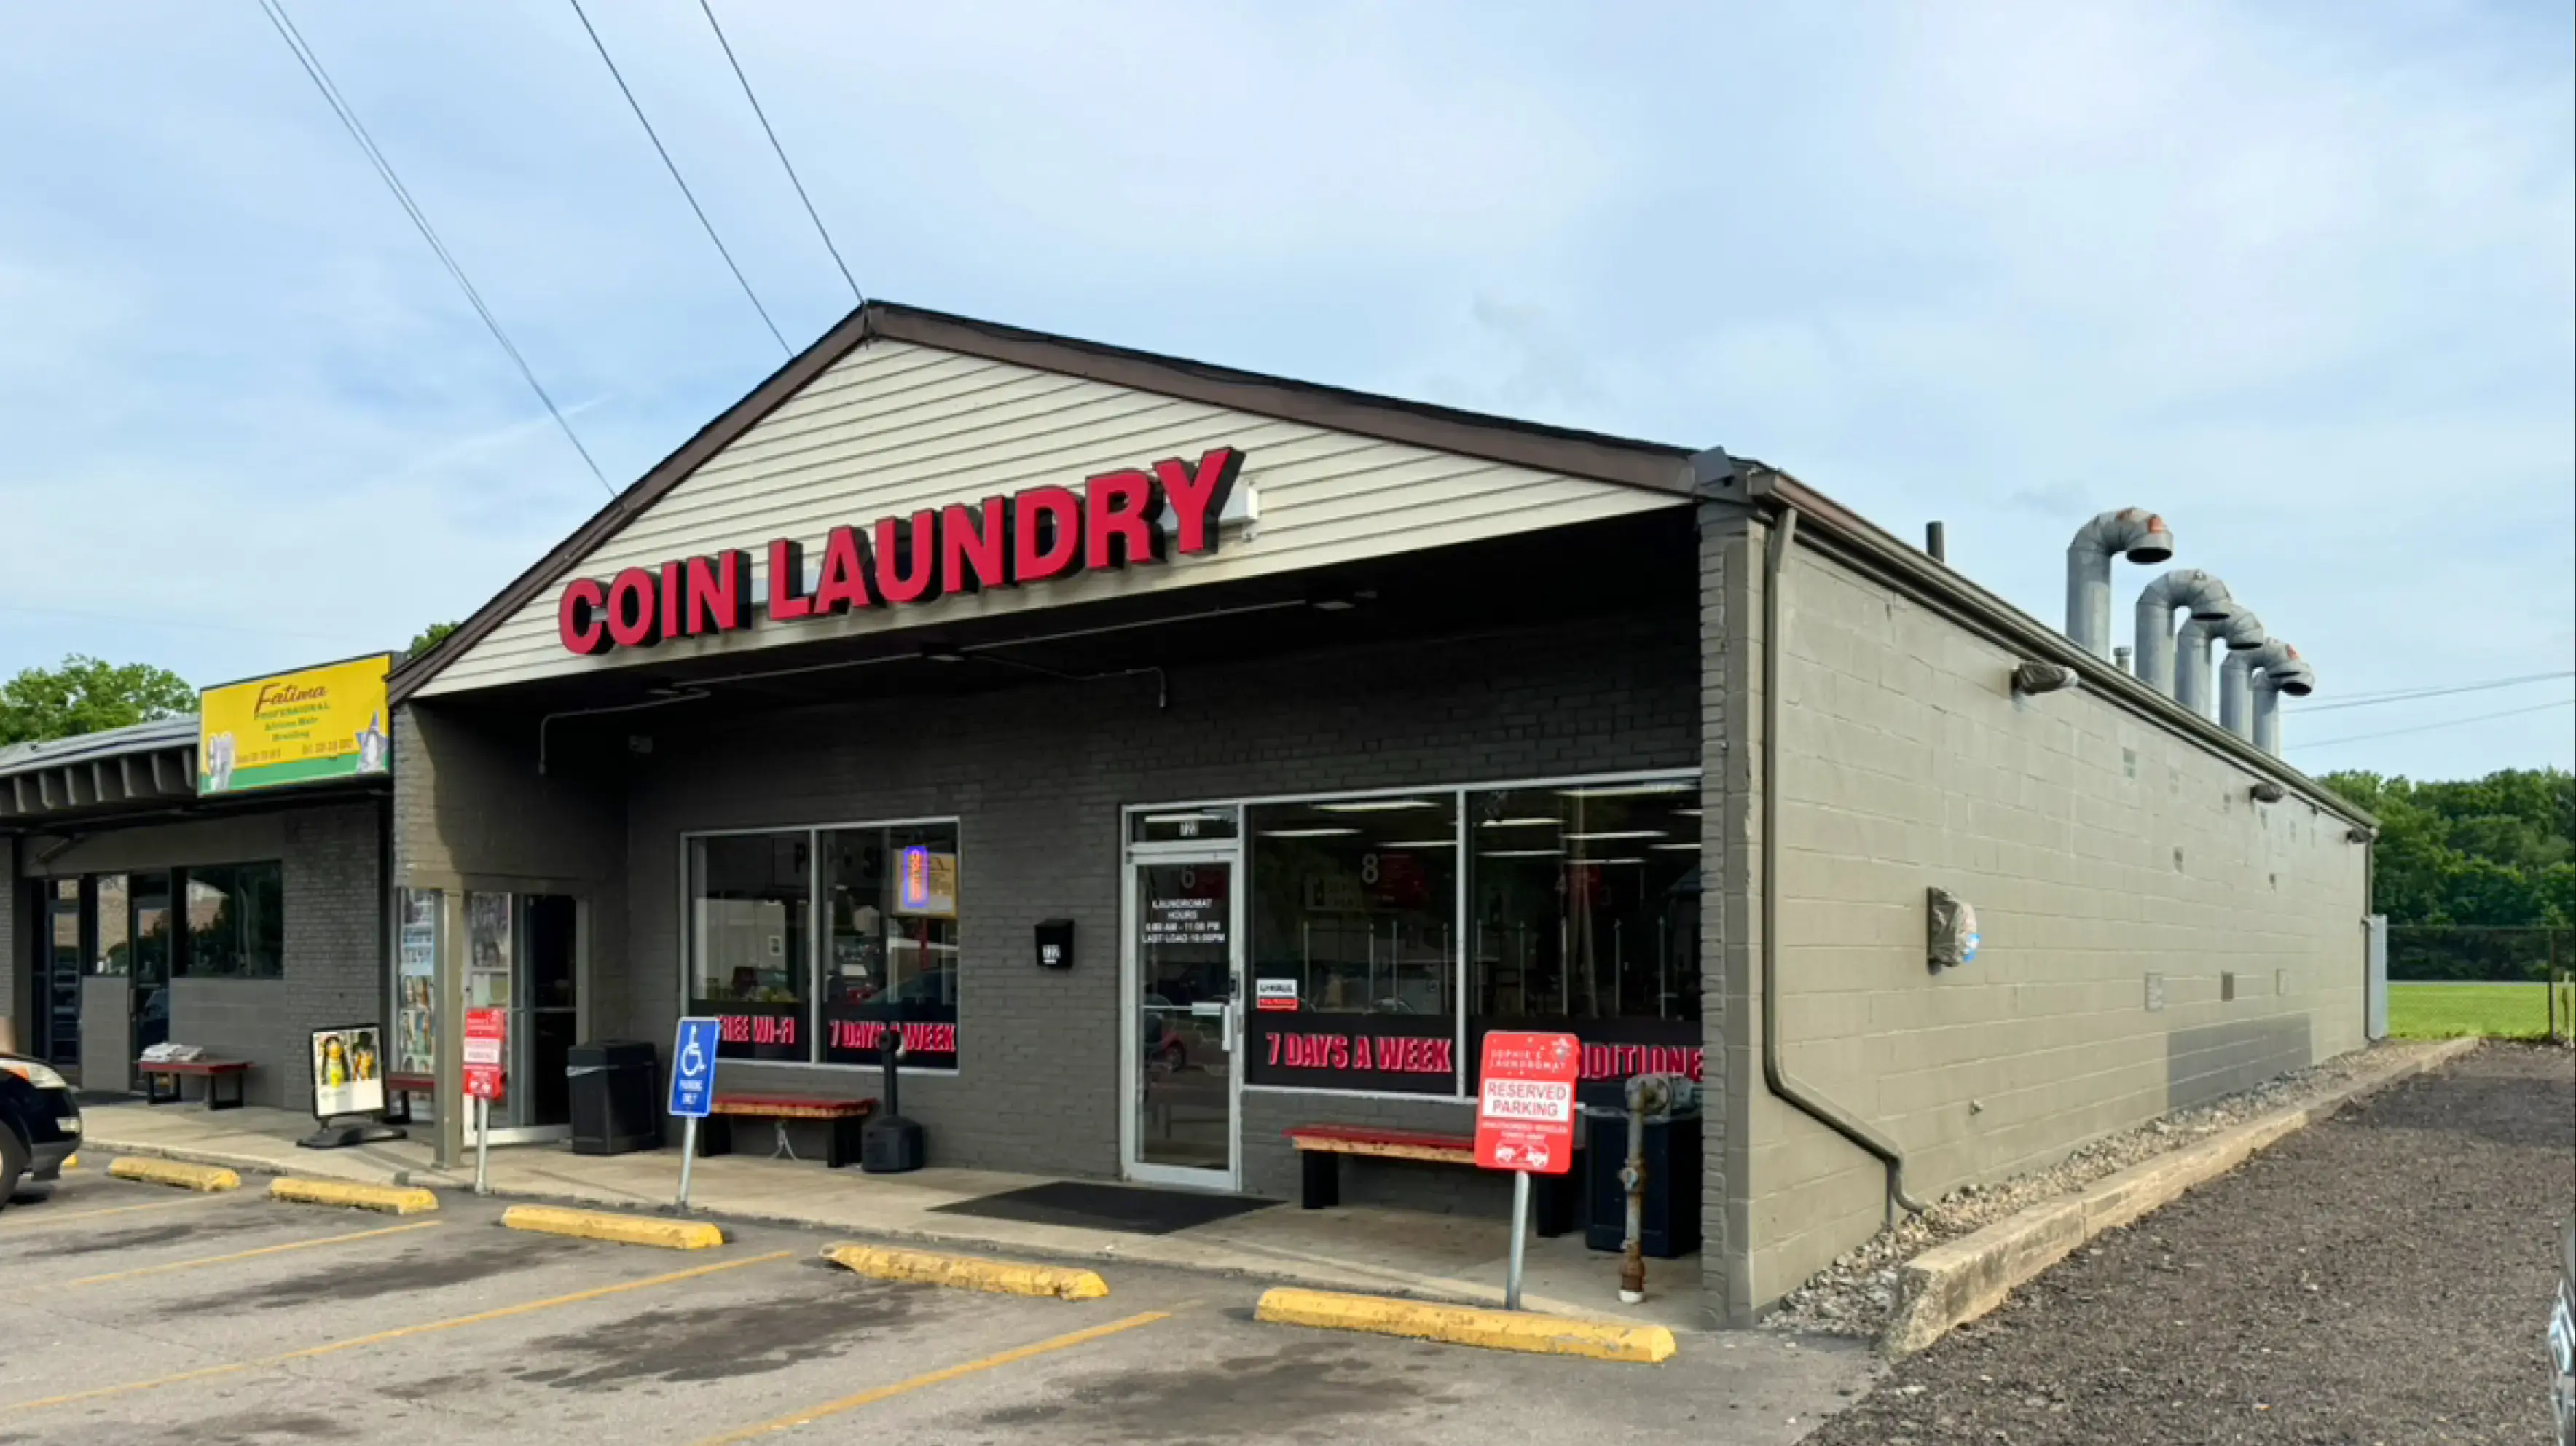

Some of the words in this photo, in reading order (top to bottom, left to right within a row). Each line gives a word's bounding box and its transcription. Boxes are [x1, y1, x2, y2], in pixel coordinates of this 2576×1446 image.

[558, 549, 745, 655] COIN
[768, 447, 1240, 621] LAUNDRY
[256, 683, 328, 715] Fatima
[1362, 853, 1378, 884] 8
[1168, 911, 1198, 919] HOURS
[753, 1015, 796, 1045] WI-FI
[828, 1021, 841, 1048] 7
[903, 1023, 956, 1052] WEEK
[1265, 1032, 1280, 1066] 7
[1284, 1033, 1348, 1069] DAYS
[1353, 1034, 1372, 1070] A
[1375, 1035, 1453, 1073] WEEK
[1486, 1082, 1566, 1101] RESERVED
[1493, 1100, 1559, 1117] PARKING
